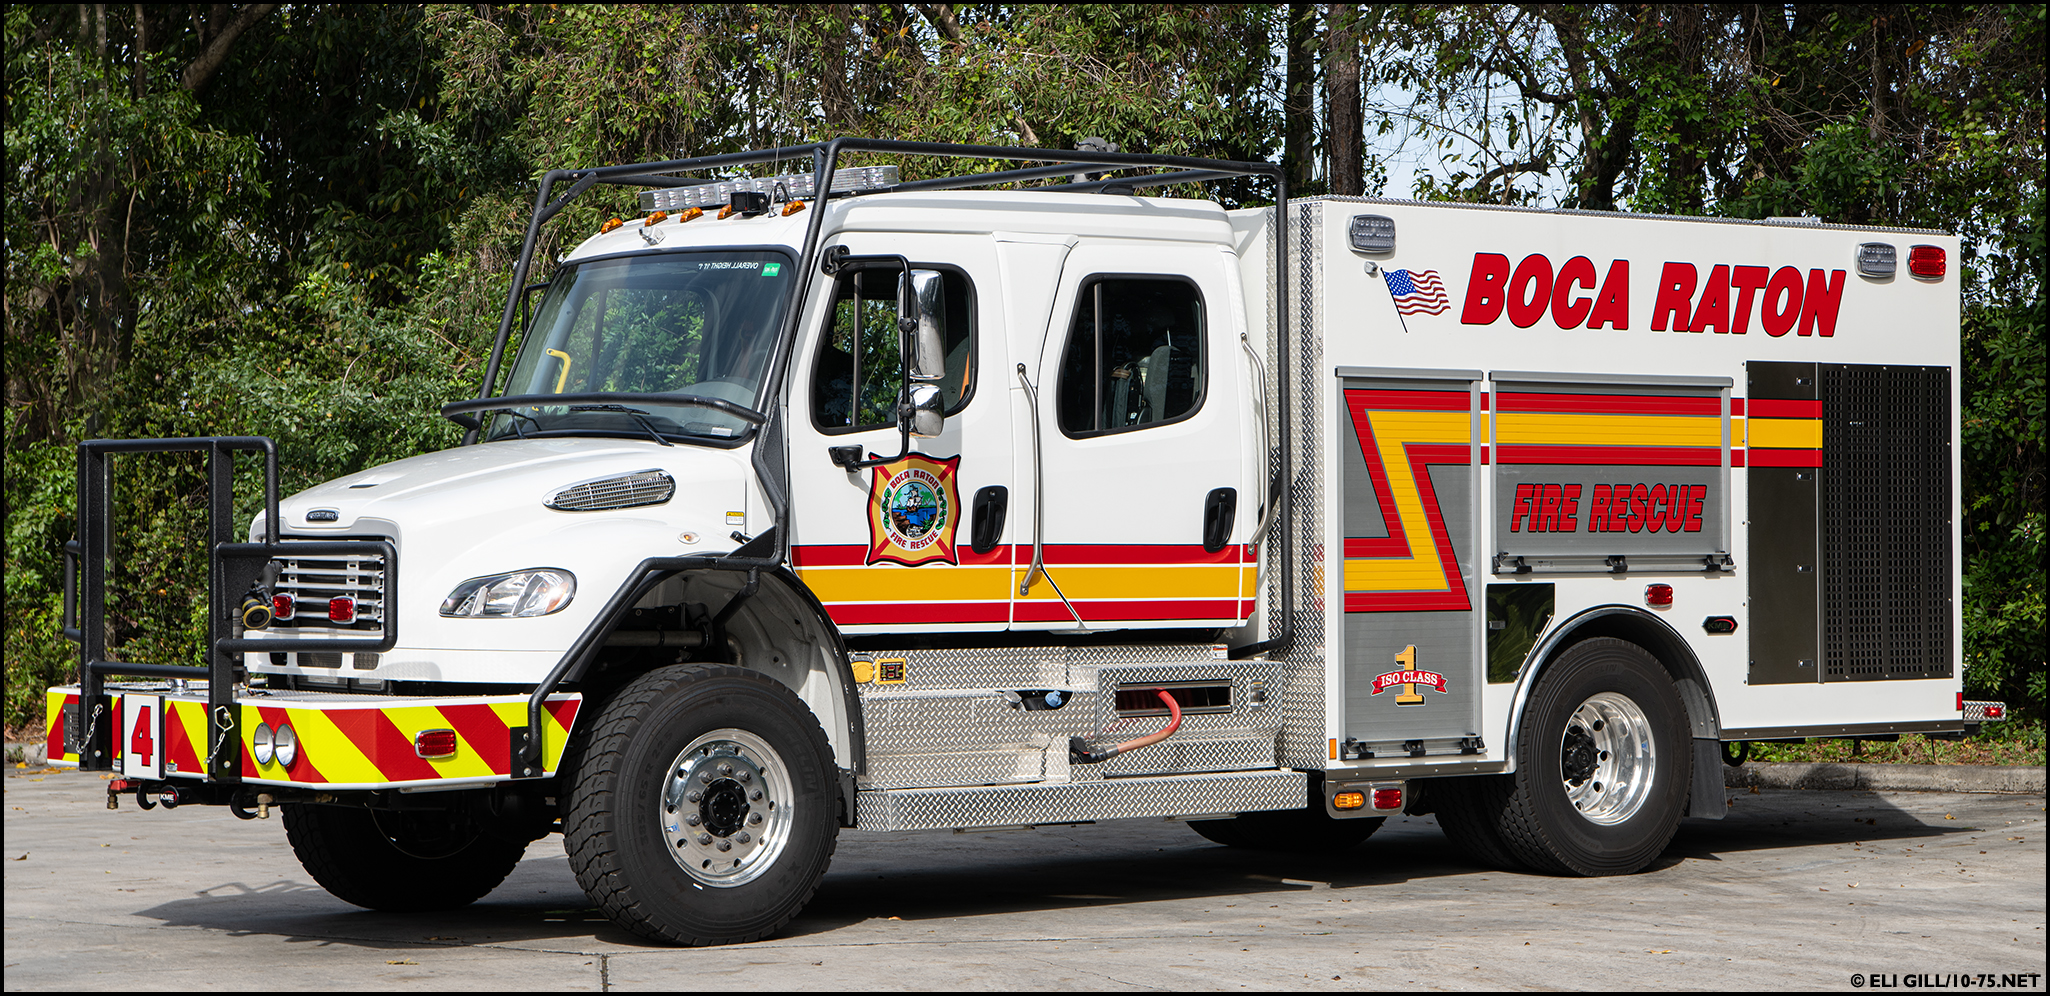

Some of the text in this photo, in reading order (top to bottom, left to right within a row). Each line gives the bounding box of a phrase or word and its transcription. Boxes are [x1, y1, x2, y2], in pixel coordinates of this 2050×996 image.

[1460, 252, 1847, 338] BOCA RATON
[889, 469, 940, 490] BOCA RATON
[1510, 483, 1707, 533] FIRE RESCUE
[890, 531, 907, 548] FIRE
[910, 530, 939, 550] RESCUE
[1380, 672, 1438, 687] ISO CLASS
[1394, 645, 1426, 707] 1
[131, 705, 153, 766] 4
[160, 793, 175, 801] KME
